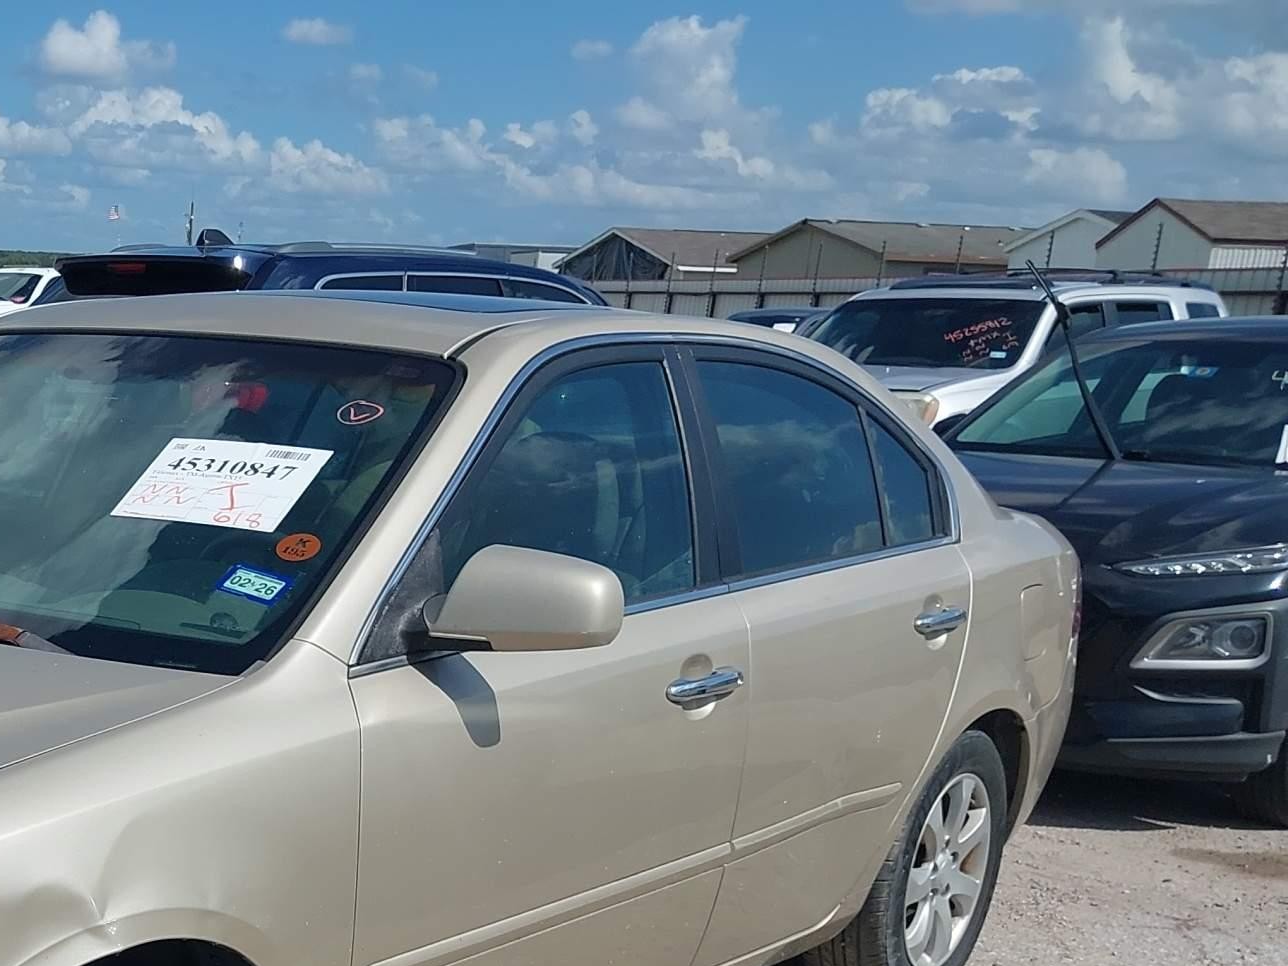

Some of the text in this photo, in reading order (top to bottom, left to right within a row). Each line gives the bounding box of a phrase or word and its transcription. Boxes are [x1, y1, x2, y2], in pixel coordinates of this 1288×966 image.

[168, 456, 298, 481] 45310847
[230, 574, 248, 590] 02
[254, 580, 275, 597] 26
